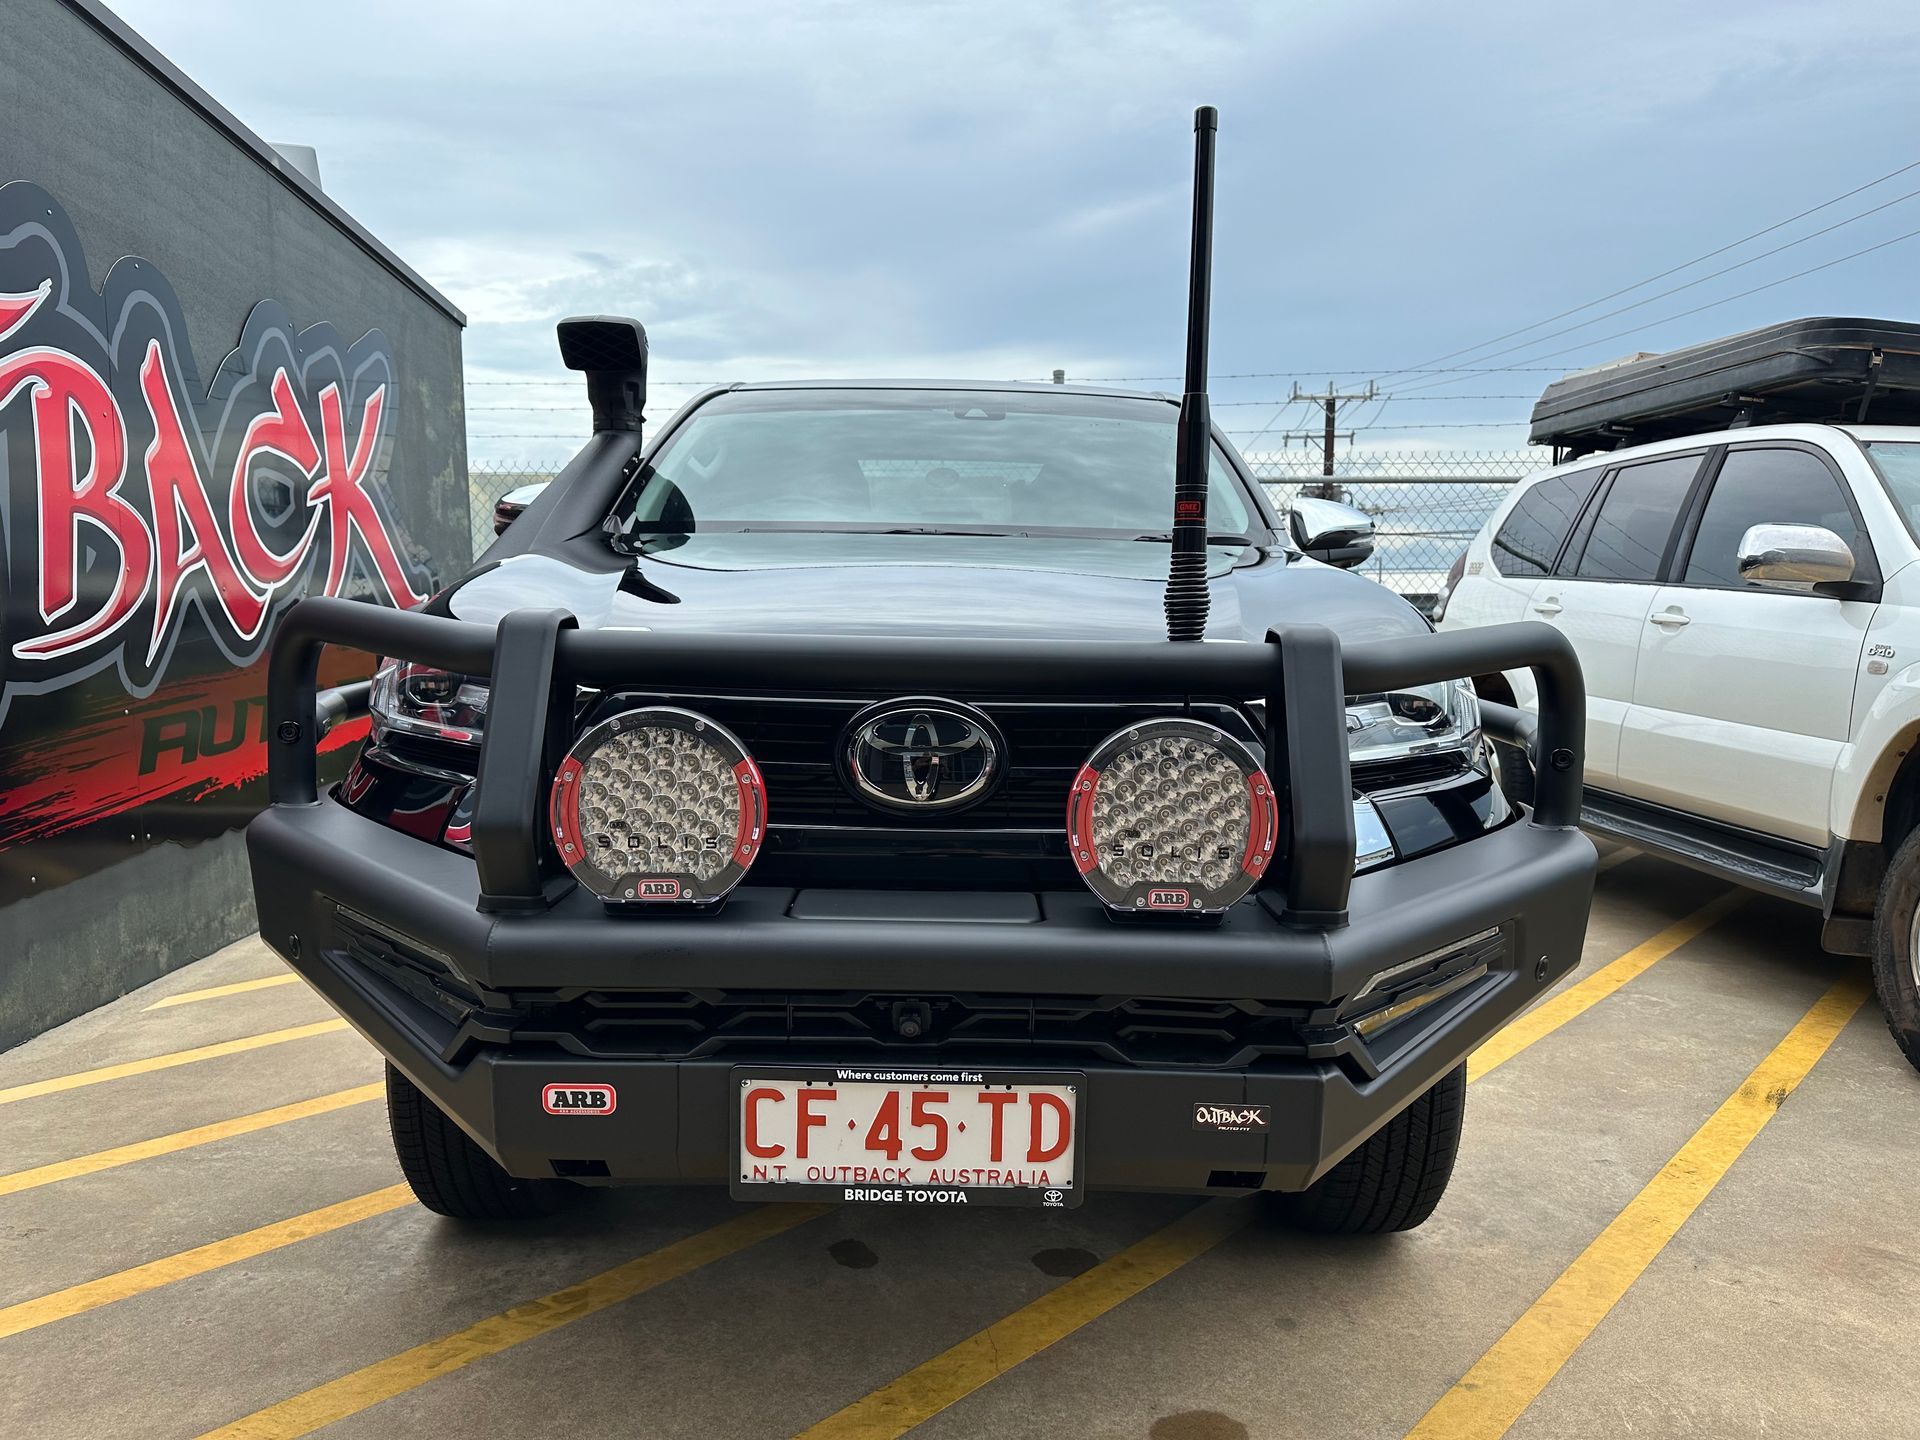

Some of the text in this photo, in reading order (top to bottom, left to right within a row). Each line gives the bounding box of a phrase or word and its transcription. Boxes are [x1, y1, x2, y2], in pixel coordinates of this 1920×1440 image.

[598, 836, 717, 849] SOLIS
[1113, 845, 1230, 860] SOLIS
[642, 884, 676, 895] ARB
[1152, 893, 1186, 904] ARB
[837, 1069, 983, 1082] Where customers come first
[552, 1091, 607, 1109] ARB
[1196, 1106, 1266, 1125] OUTBACK
[807, 1166, 912, 1184] OUTBACK
[928, 1168, 1051, 1185] AUSTRALIA
[844, 1188, 968, 1203] BRIDGE TOYOTA
